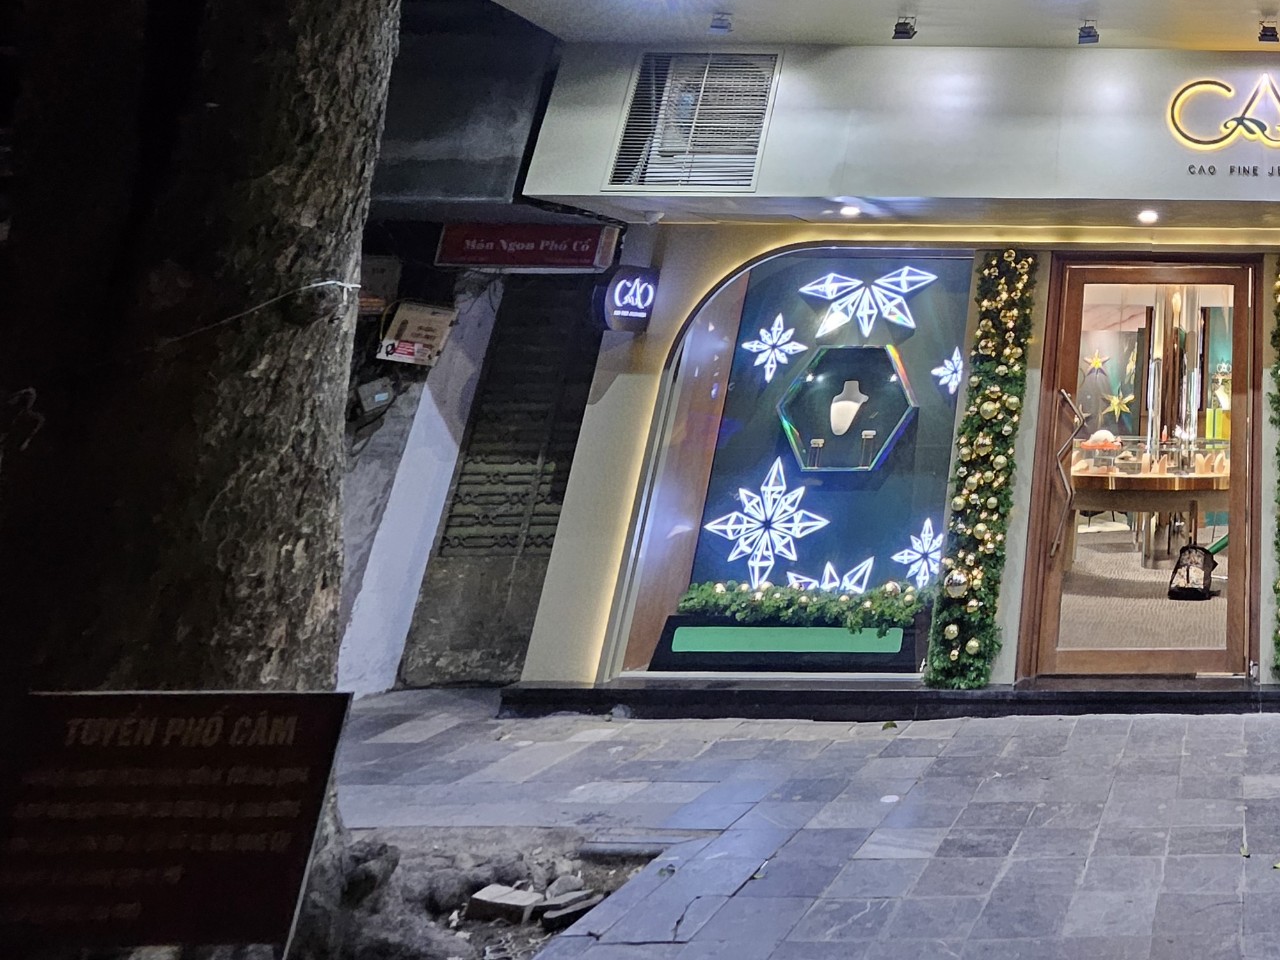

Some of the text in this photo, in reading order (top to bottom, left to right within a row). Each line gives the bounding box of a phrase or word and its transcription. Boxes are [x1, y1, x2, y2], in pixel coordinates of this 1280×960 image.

[1187, 164, 1217, 176] CAO
[1229, 165, 1259, 177] FINE
[614, 278, 654, 309] CAO
